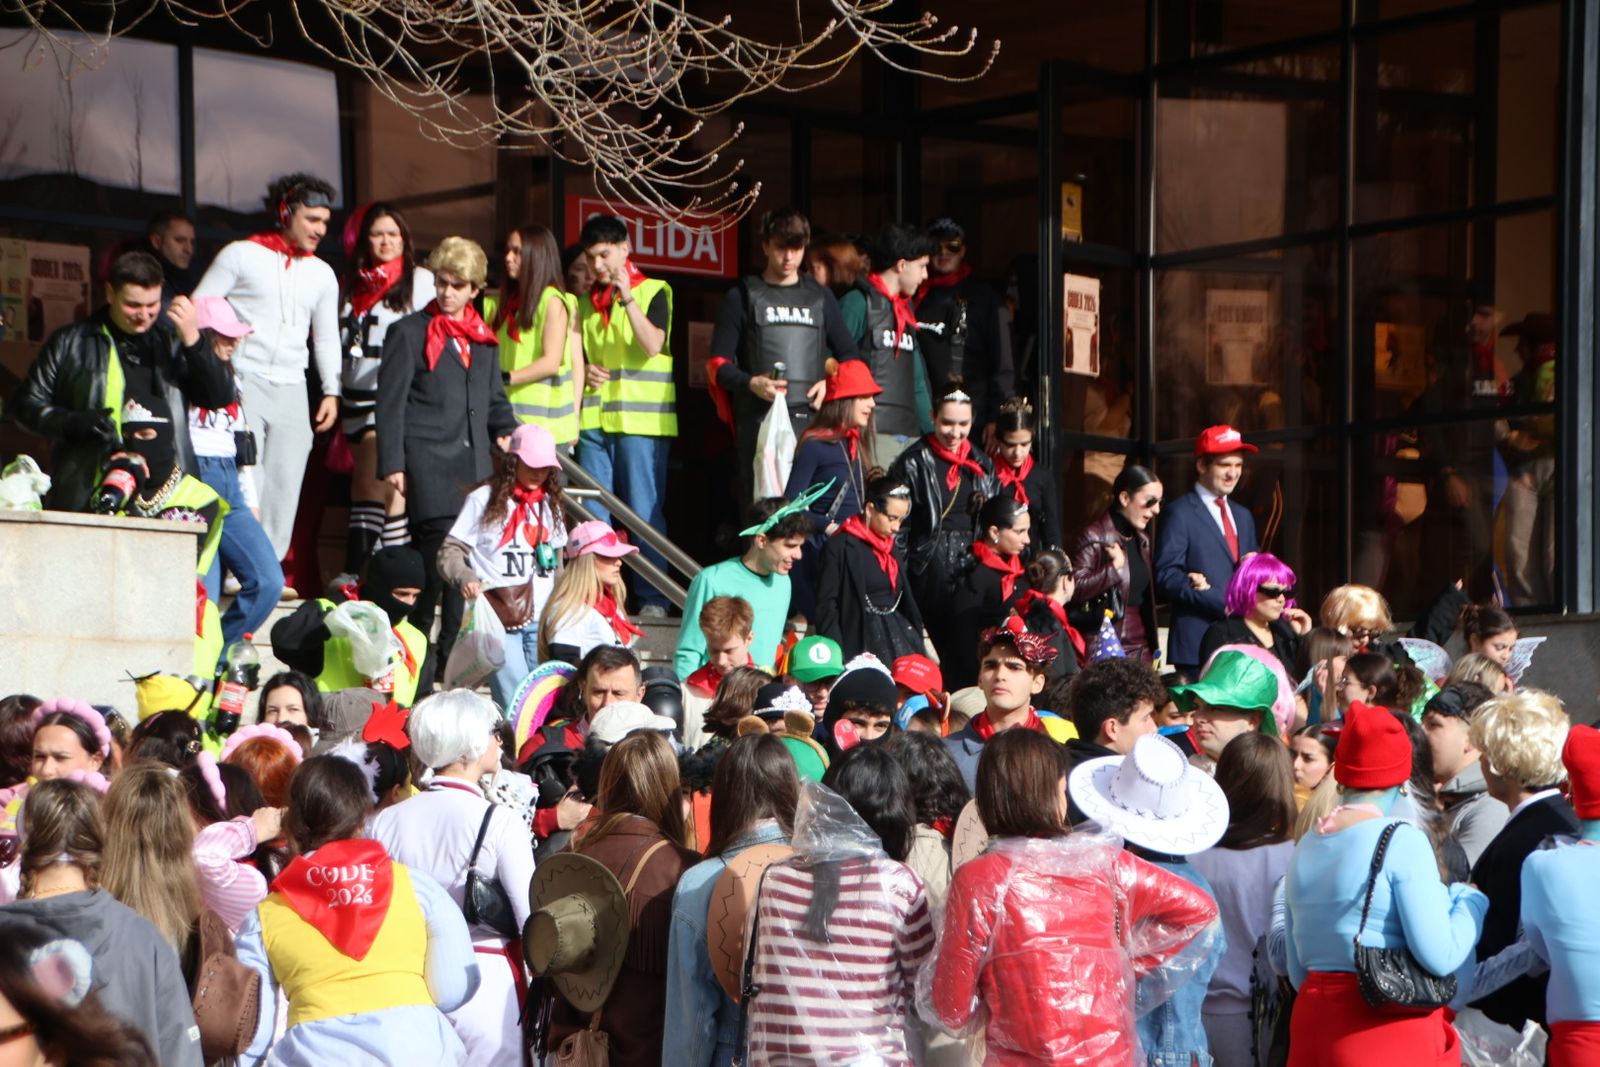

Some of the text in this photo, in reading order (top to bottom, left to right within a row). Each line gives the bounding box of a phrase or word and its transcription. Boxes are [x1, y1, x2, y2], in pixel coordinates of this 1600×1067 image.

[816, 647, 825, 659] L
[306, 863, 376, 887] CODE
[327, 882, 374, 908] 2026
